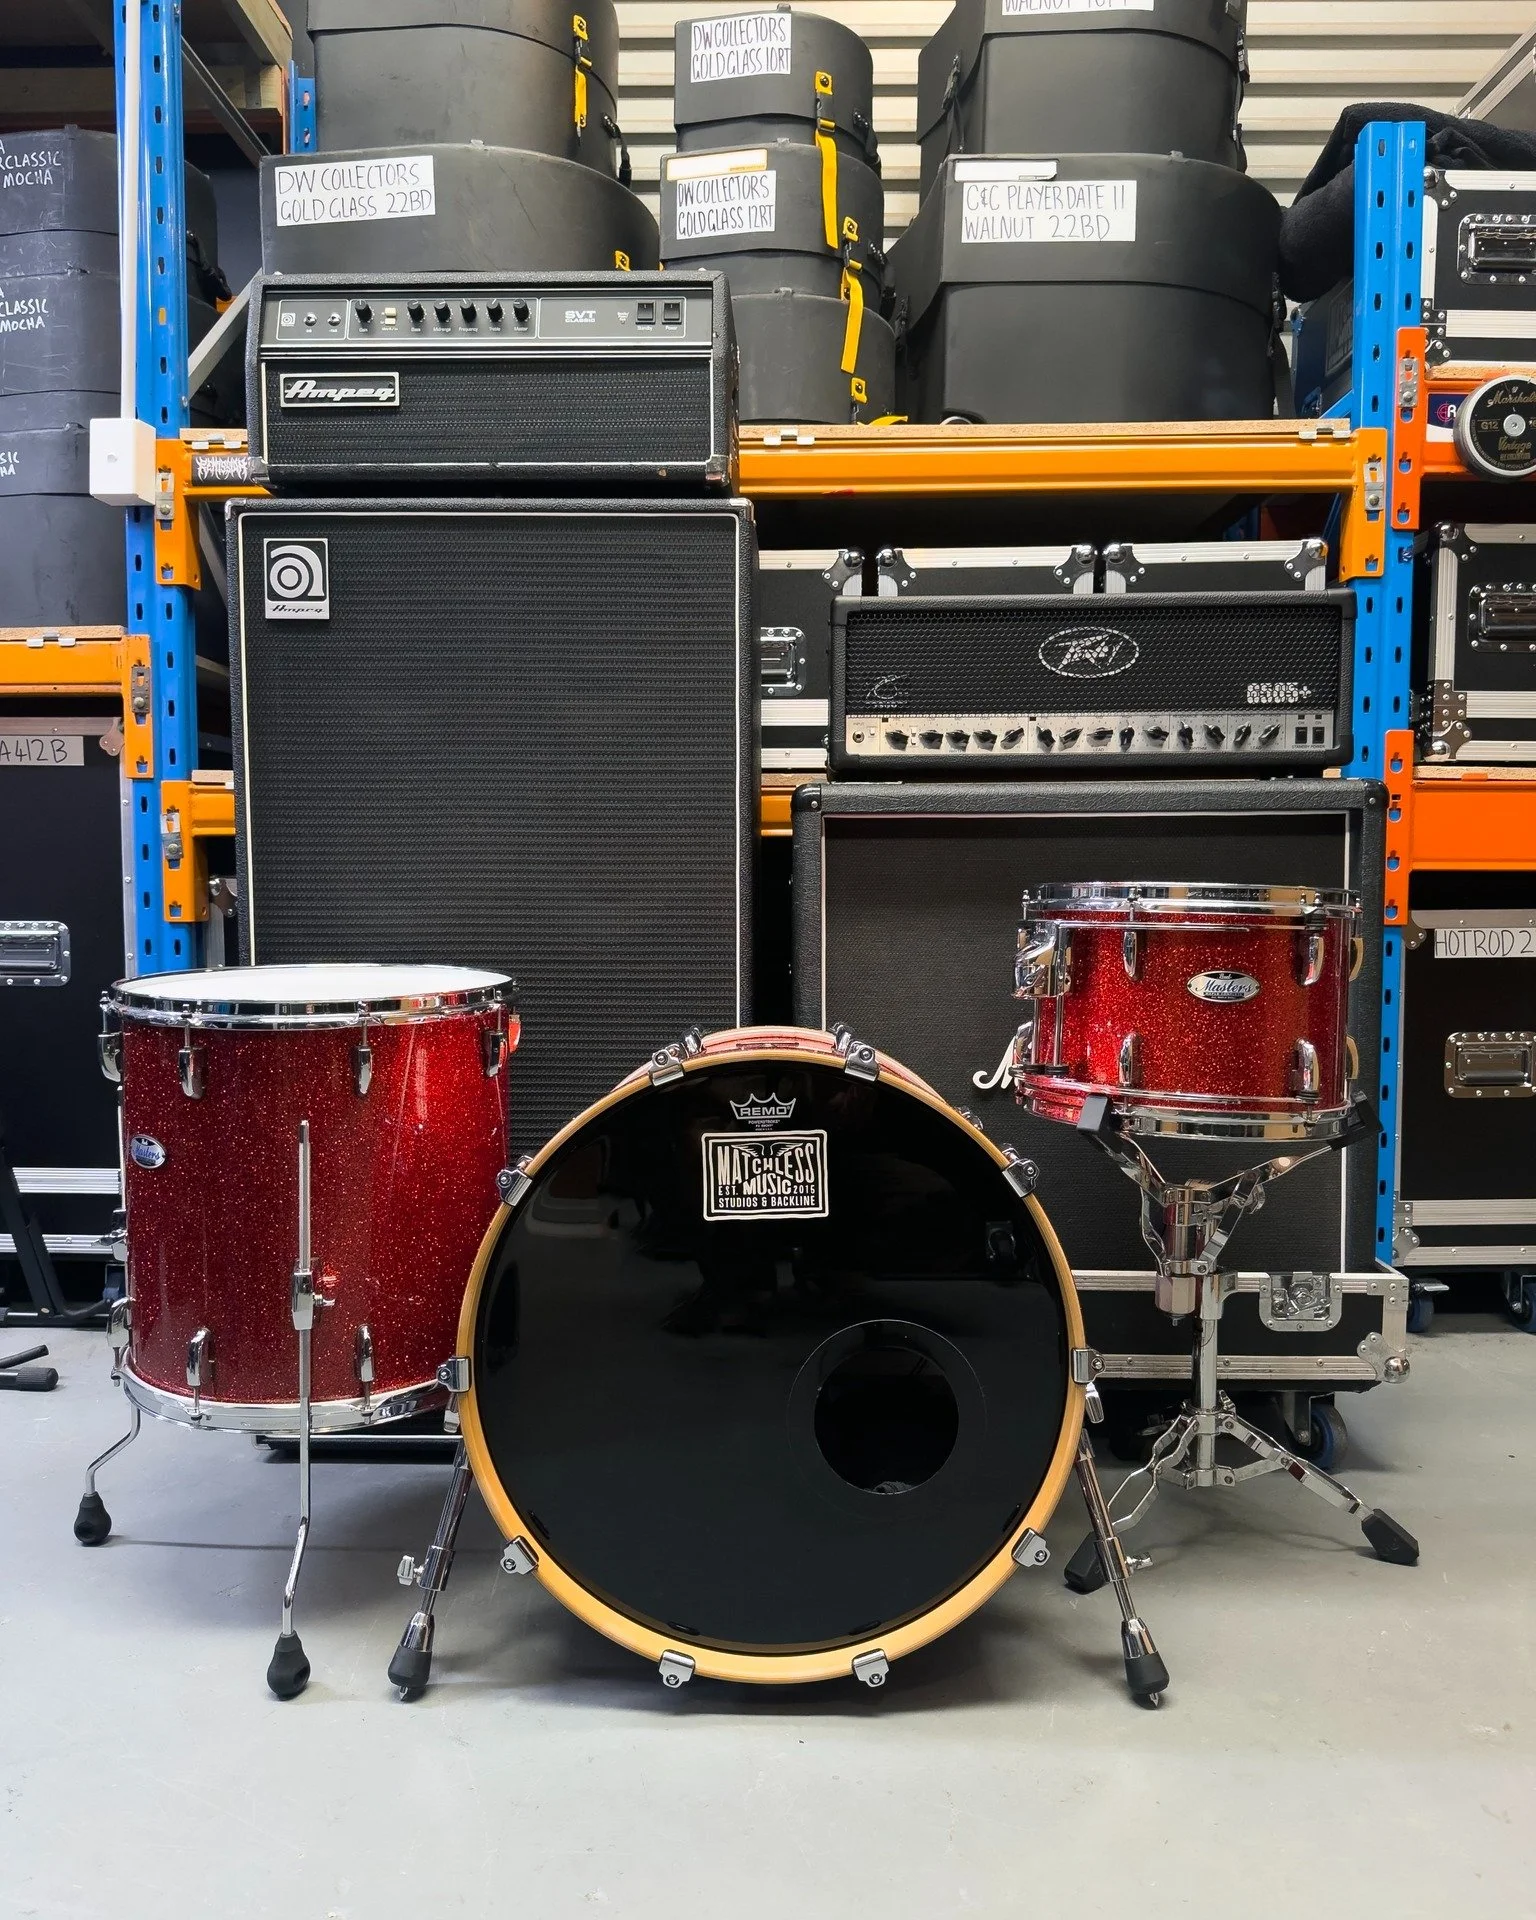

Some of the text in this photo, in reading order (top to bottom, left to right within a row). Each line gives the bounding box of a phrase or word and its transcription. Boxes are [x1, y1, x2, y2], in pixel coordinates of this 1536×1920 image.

[693, 16, 786, 51] DW COLLECTORS
[692, 46, 792, 80] GOLD GLASS 10RT
[3, 169, 54, 189] MOCHA
[278, 163, 420, 194] DW COLLECTORS
[678, 174, 770, 207] DW COLLECTORS
[280, 189, 432, 223] GOLD GLASS 22BD
[966, 184, 1001, 211] C&C
[678, 204, 774, 238] GOLD GLASS 12RT
[964, 214, 1111, 241] WALNUT 22BD
[0, 315, 46, 334] MOCHA
[565, 310, 596, 319] SVT
[284, 379, 396, 401] Ampeg
[1480, 421, 1499, 430] G12
[1195, 980, 1252, 993] Masters
[740, 1106, 788, 1117] REMO
[717, 1142, 815, 1185] MATCHLESS
[718, 1172, 816, 1196] EST. MUSIC 2015
[718, 1195, 816, 1208] STUDIOS & BACKLINE
